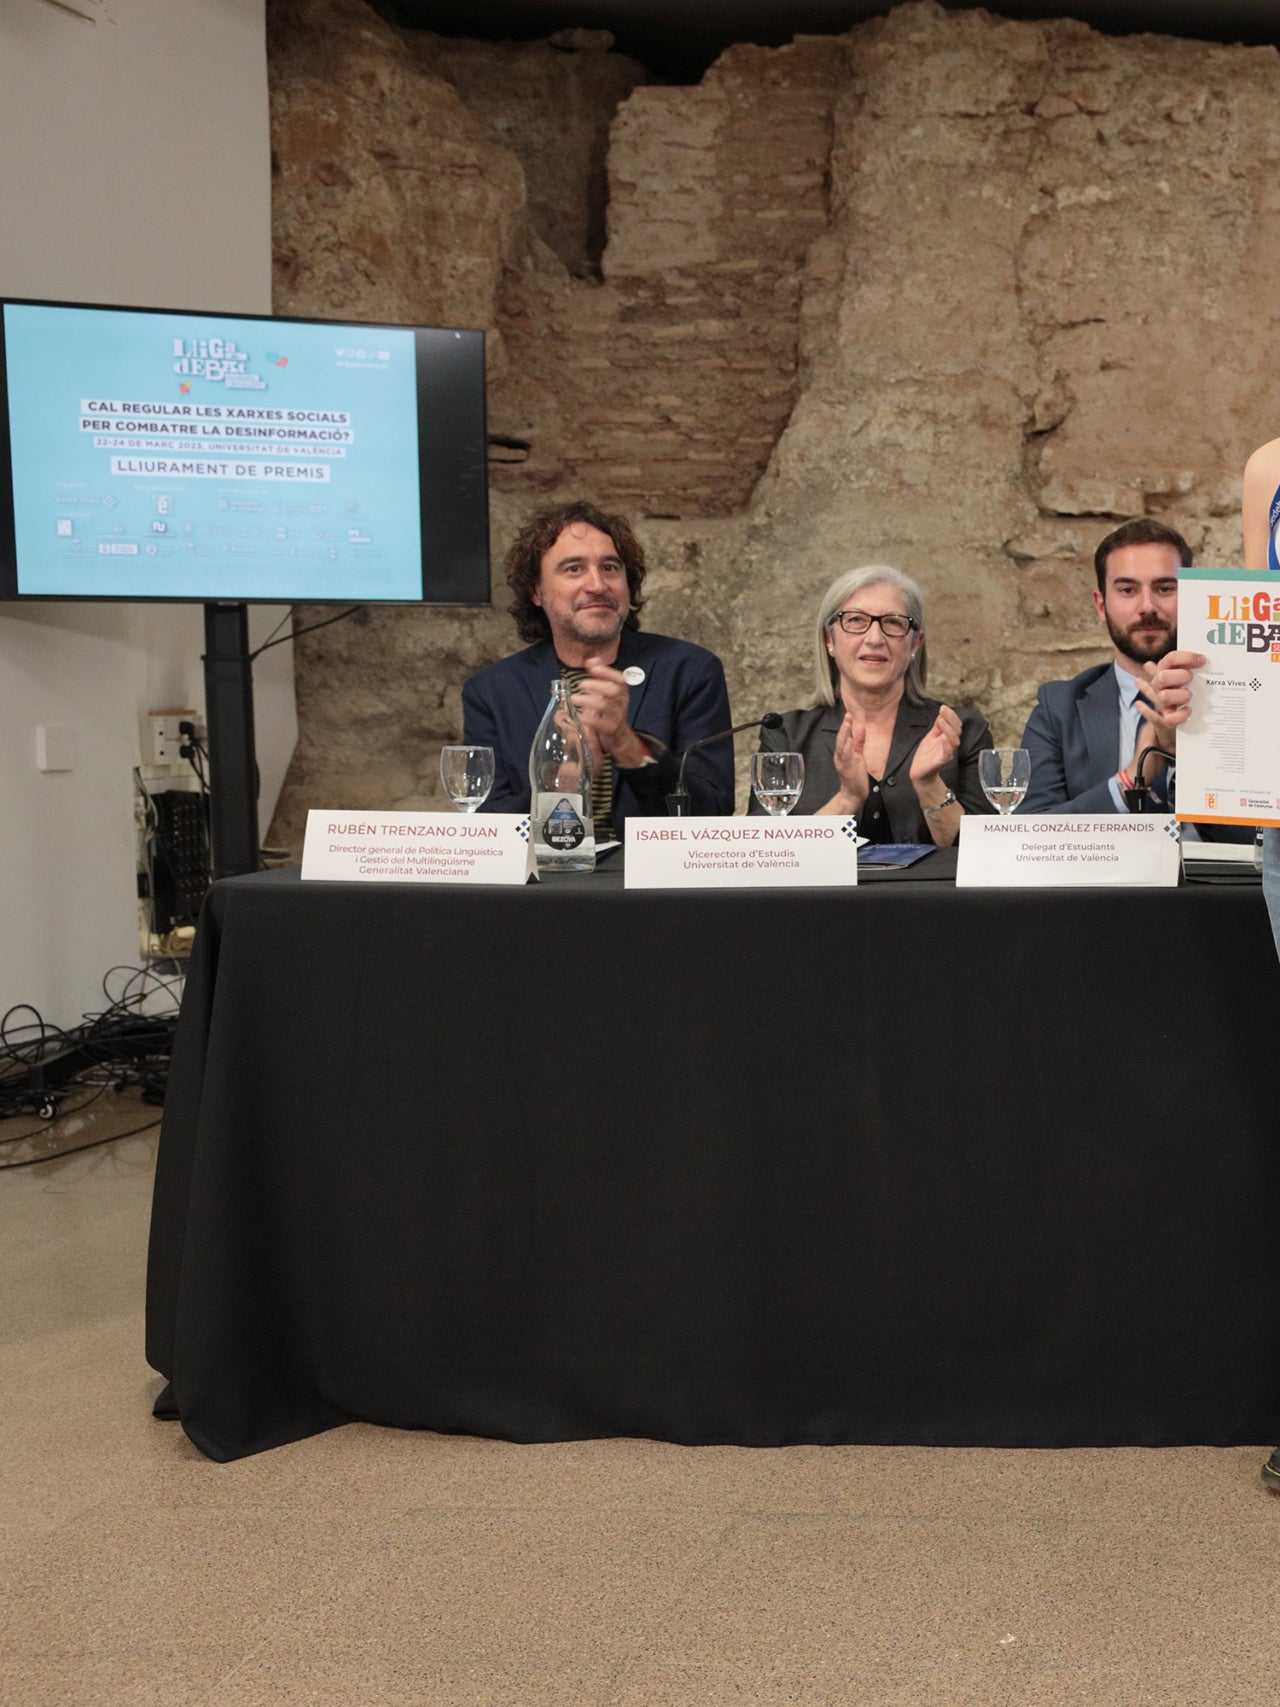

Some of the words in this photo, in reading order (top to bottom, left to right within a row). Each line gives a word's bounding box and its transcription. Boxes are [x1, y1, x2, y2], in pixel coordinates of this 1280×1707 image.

[88, 401, 118, 412] CAL
[122, 403, 191, 415] REGULAR
[196, 407, 222, 417] LES
[226, 408, 283, 420] XARXES
[287, 411, 347, 424] SOCIALS
[82, 419, 111, 430] PER
[116, 421, 198, 434] COMBATRE
[202, 425, 220, 435] LA
[225, 426, 350, 441] DESINFORMACIÓ?
[208, 443, 272, 453] UNIVERSITAT
[118, 460, 228, 474] LLIURAMENT
[235, 465, 257, 476] DE
[264, 465, 324, 478] PREMIS
[1205, 679, 1225, 687] Xarxa
[327, 823, 377, 835] RUBÉN
[380, 825, 457, 837] TRENZANO
[460, 827, 498, 838] JUAN
[984, 823, 1029, 833] MANUEL
[1032, 822, 1090, 833] GONZÁLEZ
[1093, 823, 1155, 832] FERRANDIS
[636, 830, 687, 841] ISABEL
[691, 828, 760, 841] VÁZQUEZ
[764, 828, 834, 839] NAVARRO
[329, 844, 366, 853] Director
[368, 846, 403, 855] general
[418, 847, 454, 855] Política
[1021, 843, 1057, 851] Delegat
[688, 850, 746, 858] Vicerectora
[1015, 854, 1064, 862] Universitat
[1066, 854, 1078, 862] de
[1080, 853, 1119, 862] València
[360, 855, 389, 864] Gestió
[390, 856, 405, 864] del
[407, 857, 476, 867] Multilingüisme
[683, 860, 739, 869] Universitat
[741, 860, 754, 868] de
[757, 859, 799, 868] València
[359, 866, 413, 875] Generalitat
[416, 867, 469, 876] Valenciana
